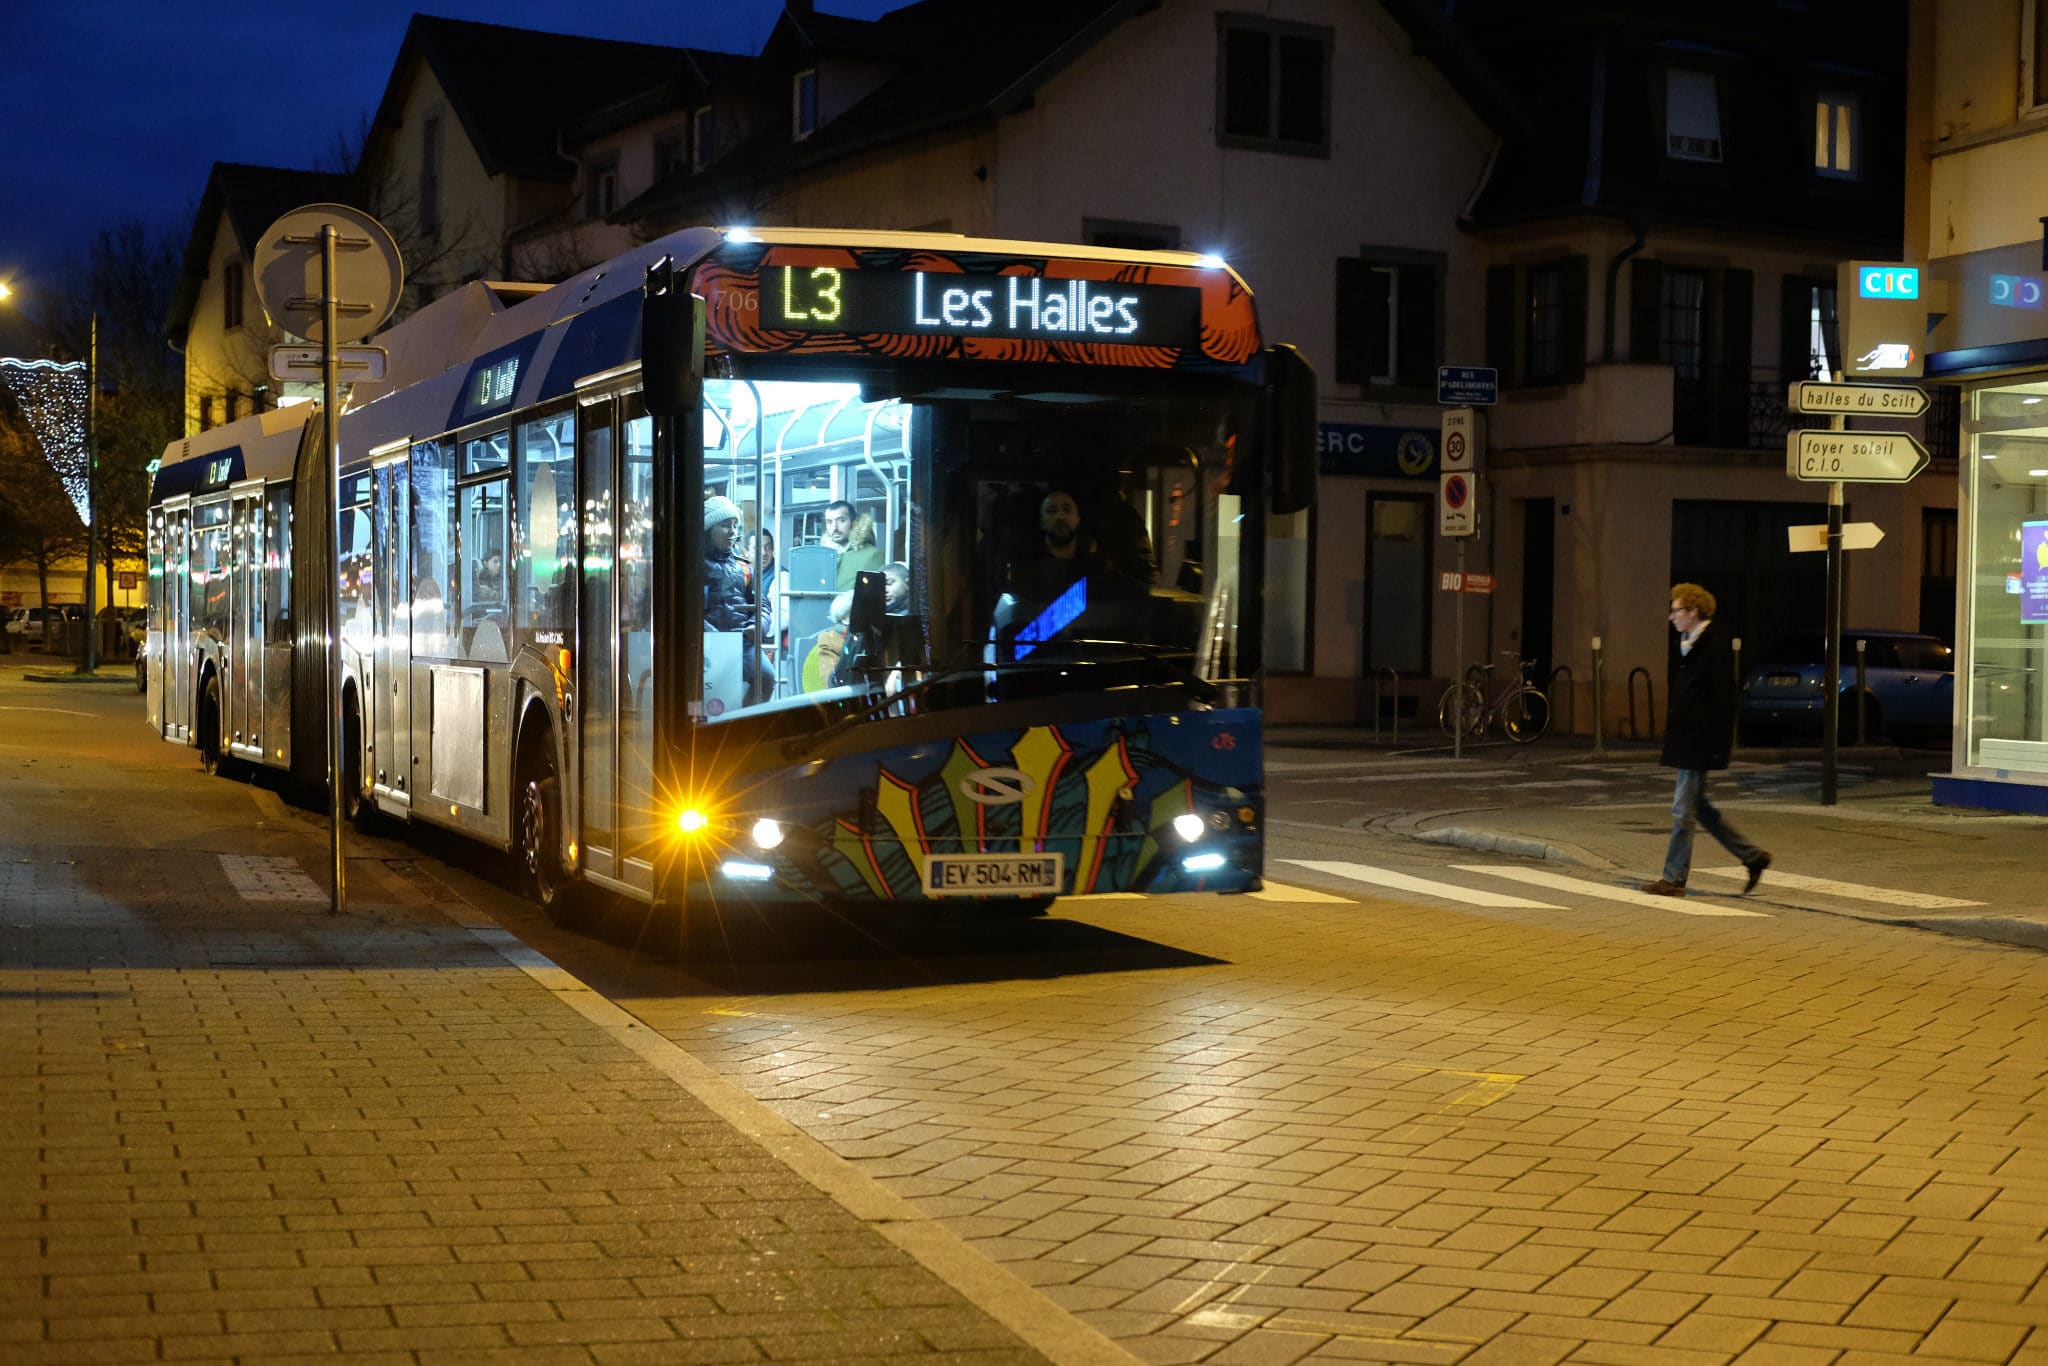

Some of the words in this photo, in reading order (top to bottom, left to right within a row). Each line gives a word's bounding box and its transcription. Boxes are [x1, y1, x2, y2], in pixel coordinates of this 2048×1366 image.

[1865, 272, 1913, 293] CIC
[715, 290, 758, 310] 706
[785, 266, 840, 320] L3
[916, 272, 992, 327] Les
[1010, 277, 1138, 333] Halles
[1807, 391, 1850, 406] halles
[1858, 393, 1874, 406] du
[1881, 393, 1915, 408] Scilt
[1448, 417, 1464, 426] ZONE
[1450, 440, 1461, 453] 30
[1806, 440, 1844, 456] foyer
[1852, 441, 1894, 455] soleil
[1806, 457, 1844, 472] C.I.O.
[1442, 573, 1462, 590] BIO
[945, 863, 1042, 885] EV-504-RM
